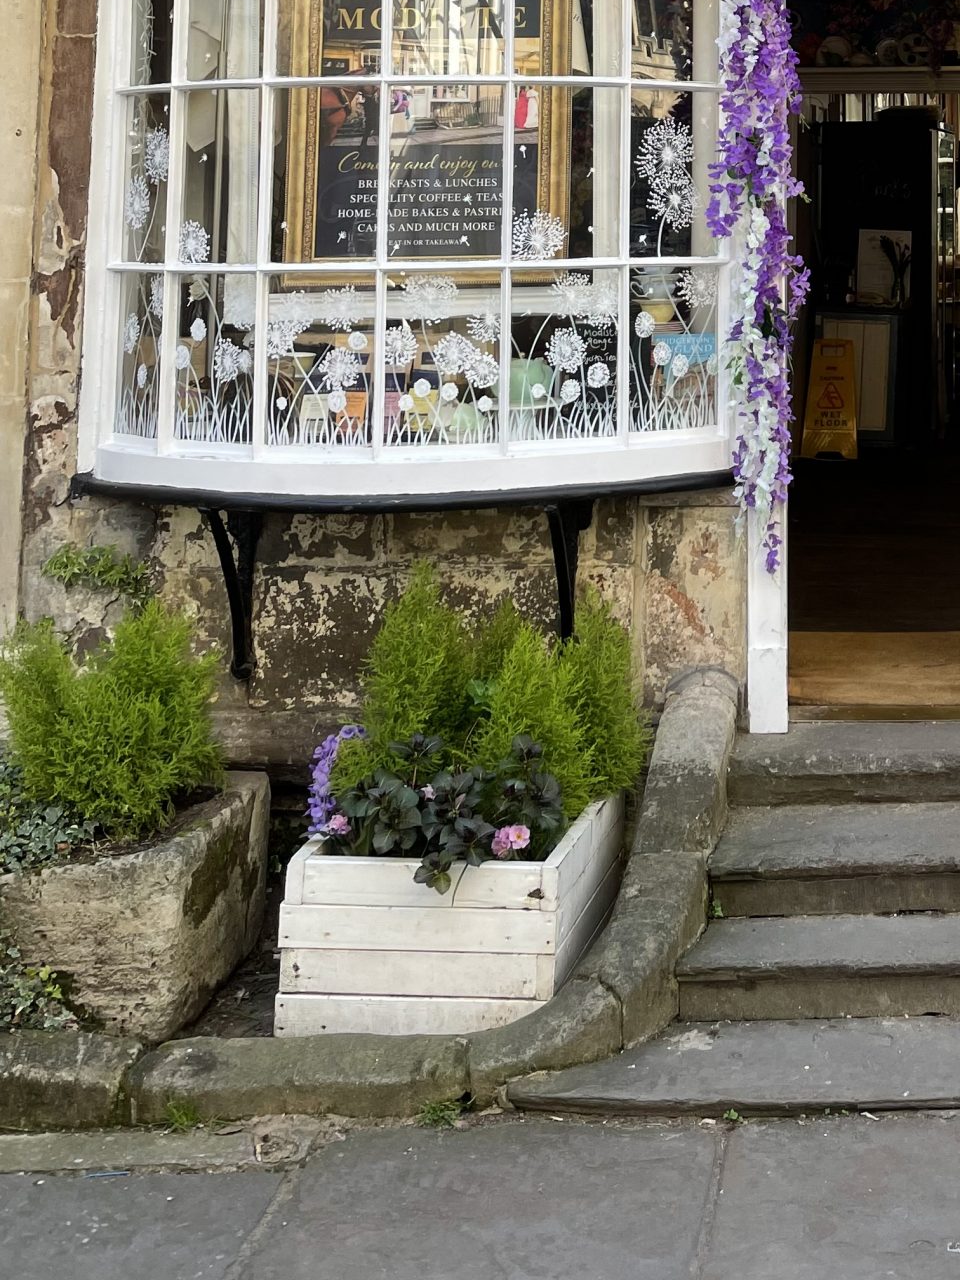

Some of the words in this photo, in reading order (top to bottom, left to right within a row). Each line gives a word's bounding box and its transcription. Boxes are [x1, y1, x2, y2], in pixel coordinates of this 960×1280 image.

[404, 153, 439, 170] and
[439, 156, 478, 178] enjoy
[358, 178, 430, 189] BREKFASTS
[433, 178, 442, 188] &
[445, 178, 498, 188] LUNCHES
[349, 193, 416, 204] SPECLITY
[418, 192, 462, 203] COFFEE
[476, 192, 503, 202] TEAS
[337, 207, 408, 218] HOME-ADE
[412, 207, 449, 218] BAKES
[451, 207, 460, 217] &
[464, 206, 516, 217] PASTRIS
[357, 223, 395, 233] CAS
[398, 223, 423, 232] AND
[425, 222, 459, 232] MUCH
[462, 222, 496, 231] MORE
